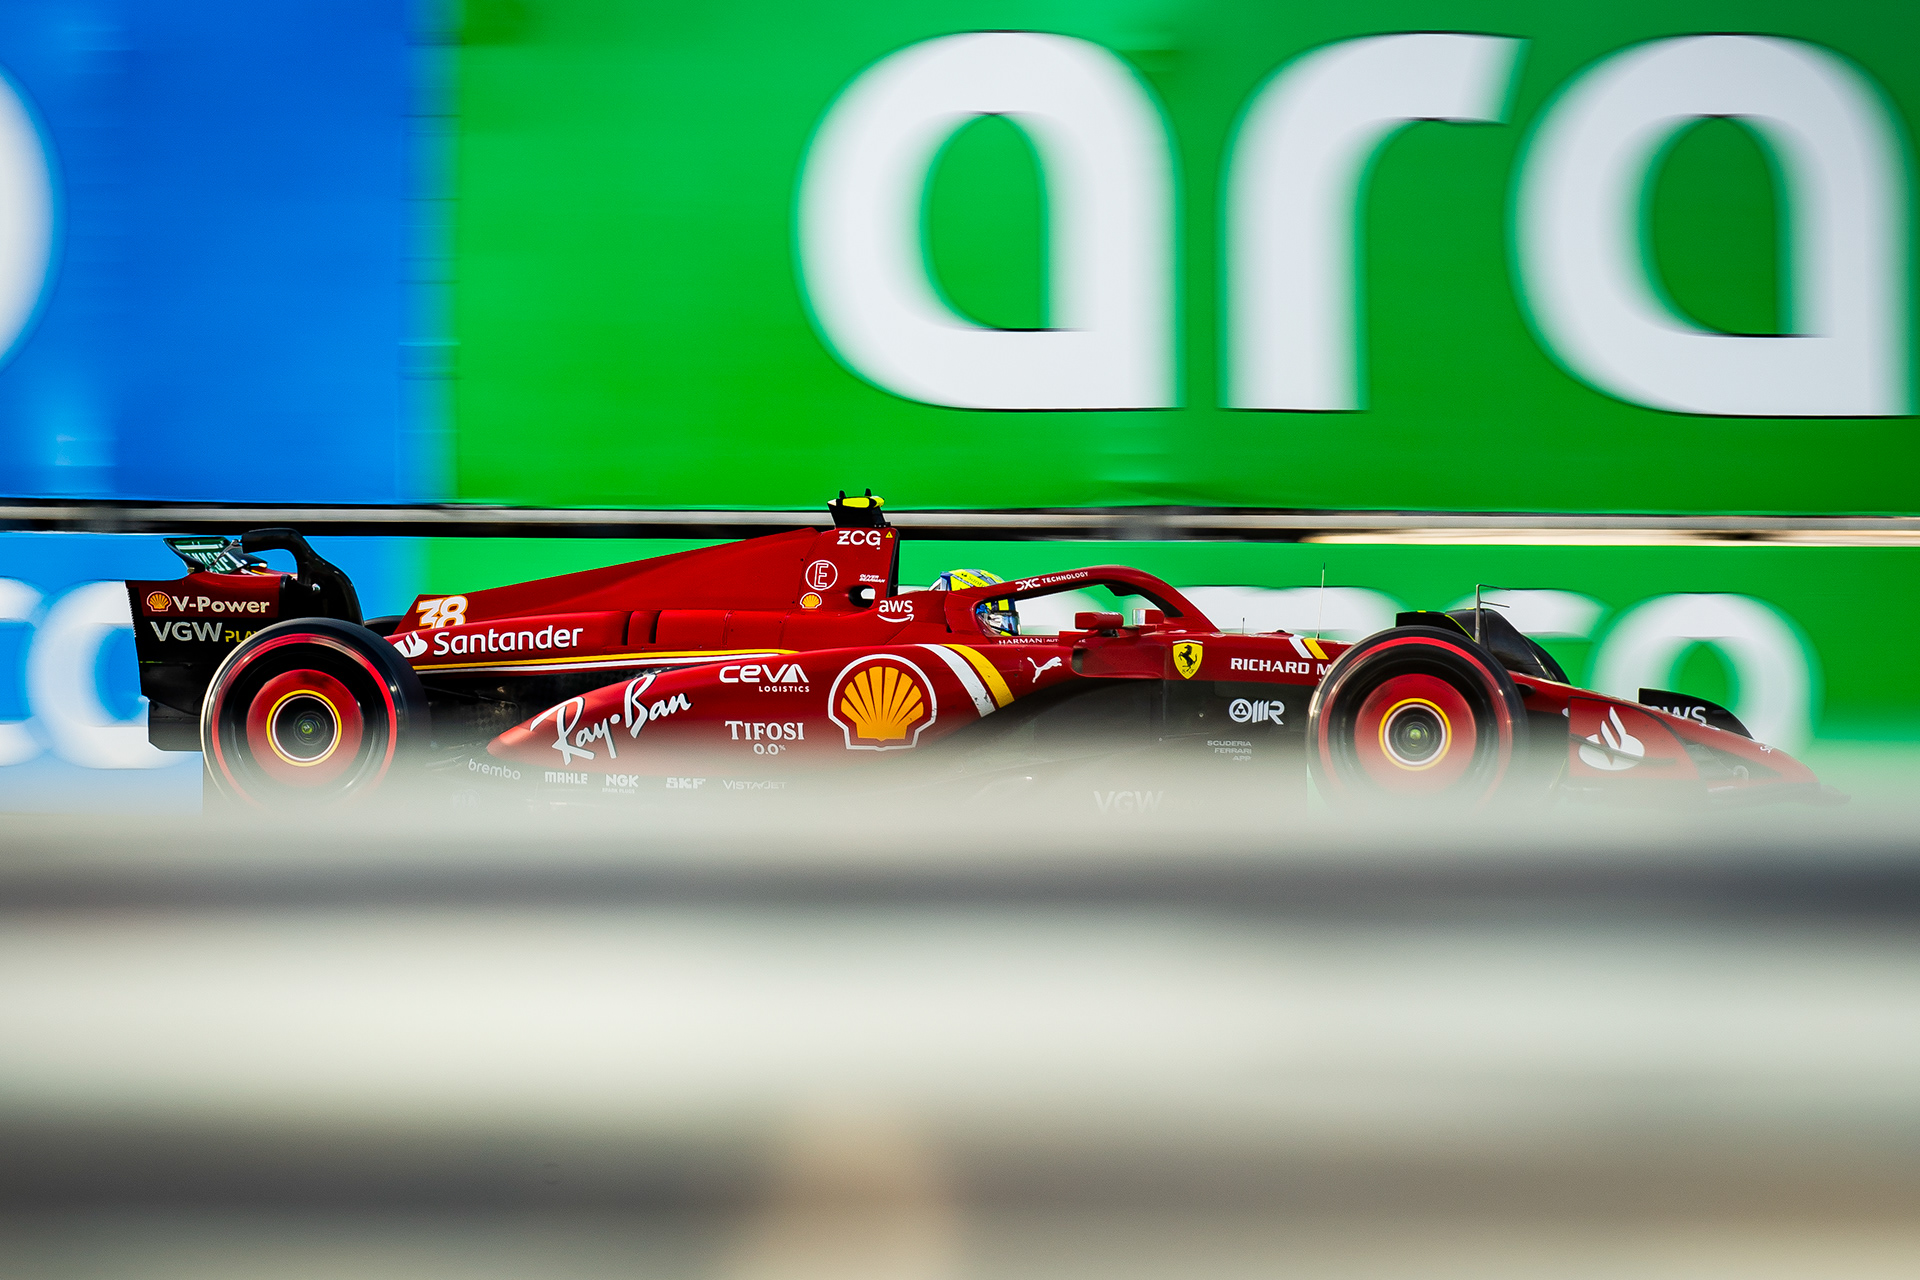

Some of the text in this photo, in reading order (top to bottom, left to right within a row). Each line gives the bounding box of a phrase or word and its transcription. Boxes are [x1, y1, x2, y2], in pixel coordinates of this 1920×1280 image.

[1041, 571, 1089, 584] TECHNOLOGY
[172, 596, 270, 613] V-Power
[415, 594, 468, 630] 38
[879, 600, 913, 613] aws
[150, 621, 257, 643] VGW PLA
[433, 625, 584, 656] Santander
[1230, 658, 1310, 675] RICHARD
[758, 685, 810, 693] LOGISTICS
[724, 720, 804, 741] TIFOSI
[468, 758, 521, 780] brembo
[544, 771, 588, 785] MAHLE
[605, 773, 639, 788] NGK
[665, 777, 707, 789] SKF
[1093, 790, 1164, 815] VGW
